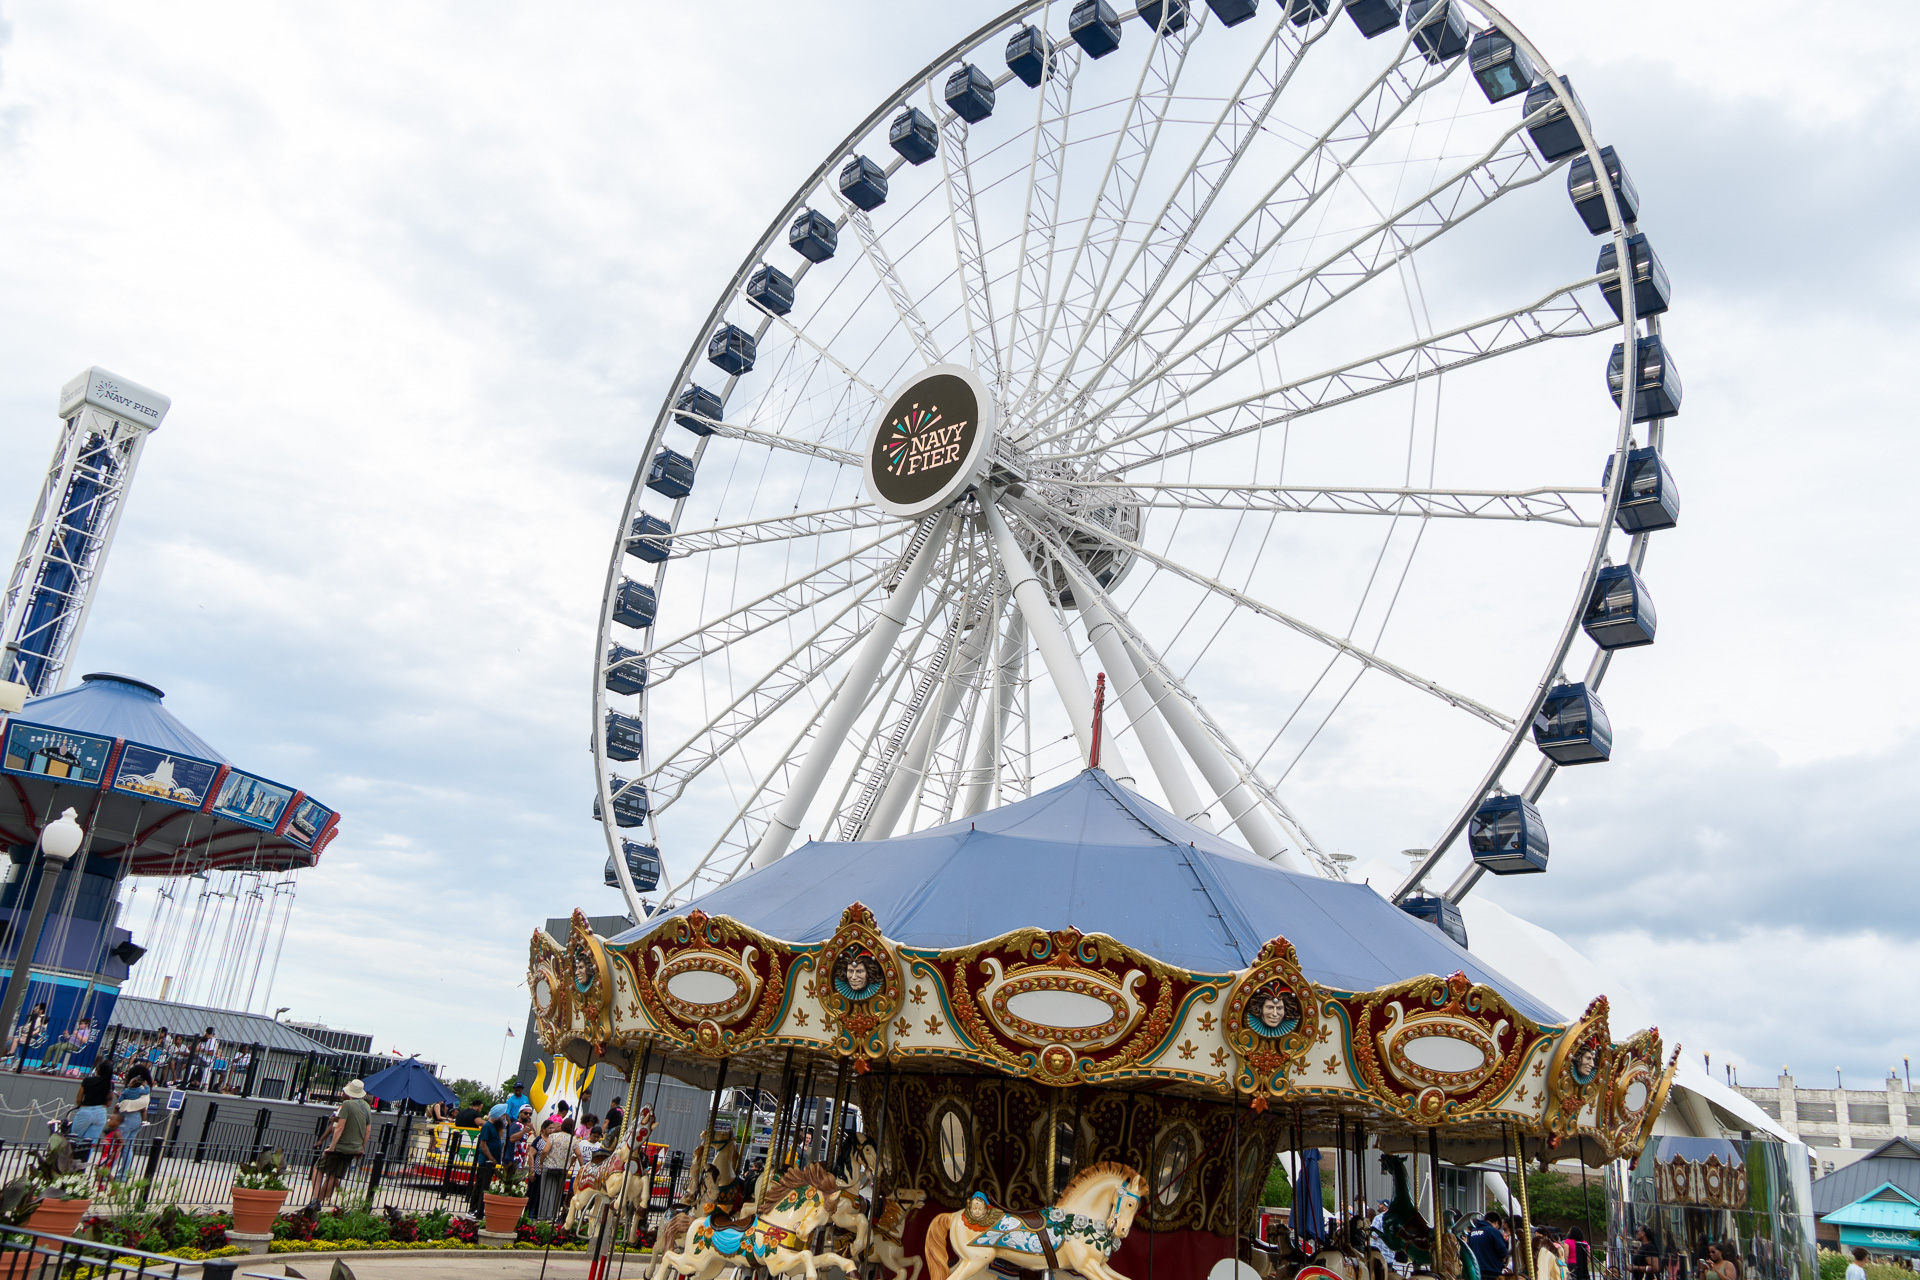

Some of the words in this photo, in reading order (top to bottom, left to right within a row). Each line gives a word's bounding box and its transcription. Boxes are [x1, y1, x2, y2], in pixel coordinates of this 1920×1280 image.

[104, 391, 132, 407] NAVY
[133, 402, 159, 418] PIER
[909, 420, 968, 456] NAVY
[907, 443, 960, 476] PIER
